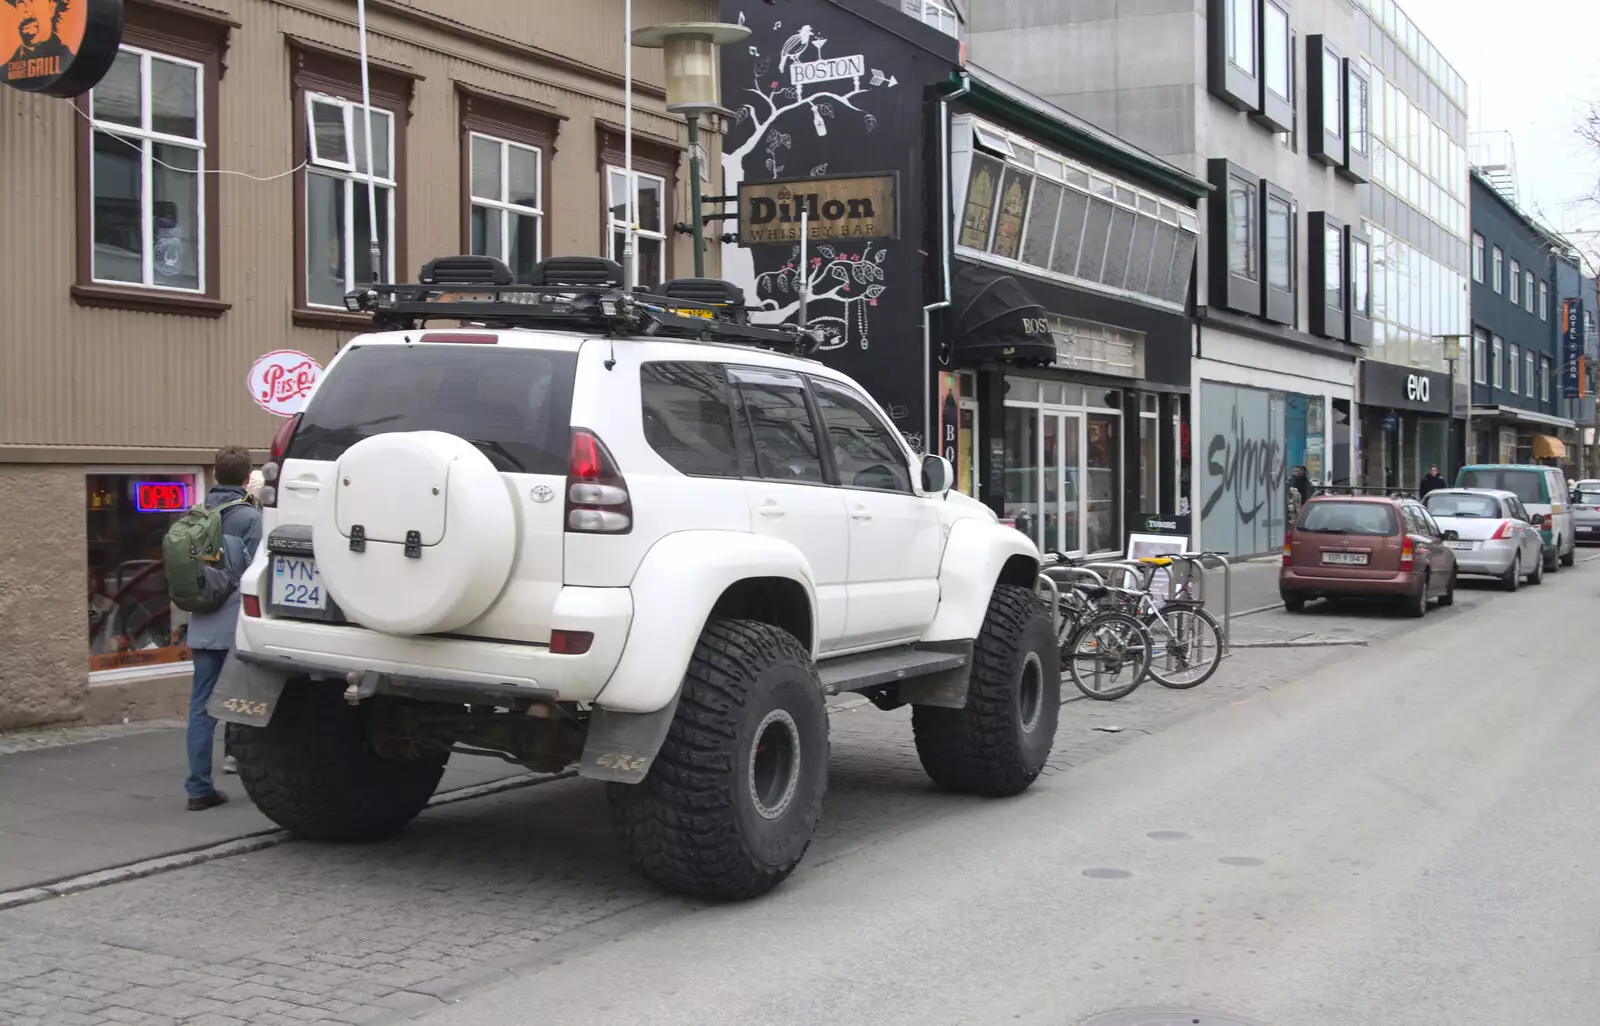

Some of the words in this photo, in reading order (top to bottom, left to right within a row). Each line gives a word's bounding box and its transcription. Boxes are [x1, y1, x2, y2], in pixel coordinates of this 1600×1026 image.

[27, 55, 61, 77] GRILL
[794, 56, 861, 83] BOSTON
[750, 189, 875, 225] Dillon
[750, 226, 832, 241] WHISEY
[841, 224, 876, 237] BAR
[1407, 374, 1430, 402] eva
[284, 583, 320, 605] 224
